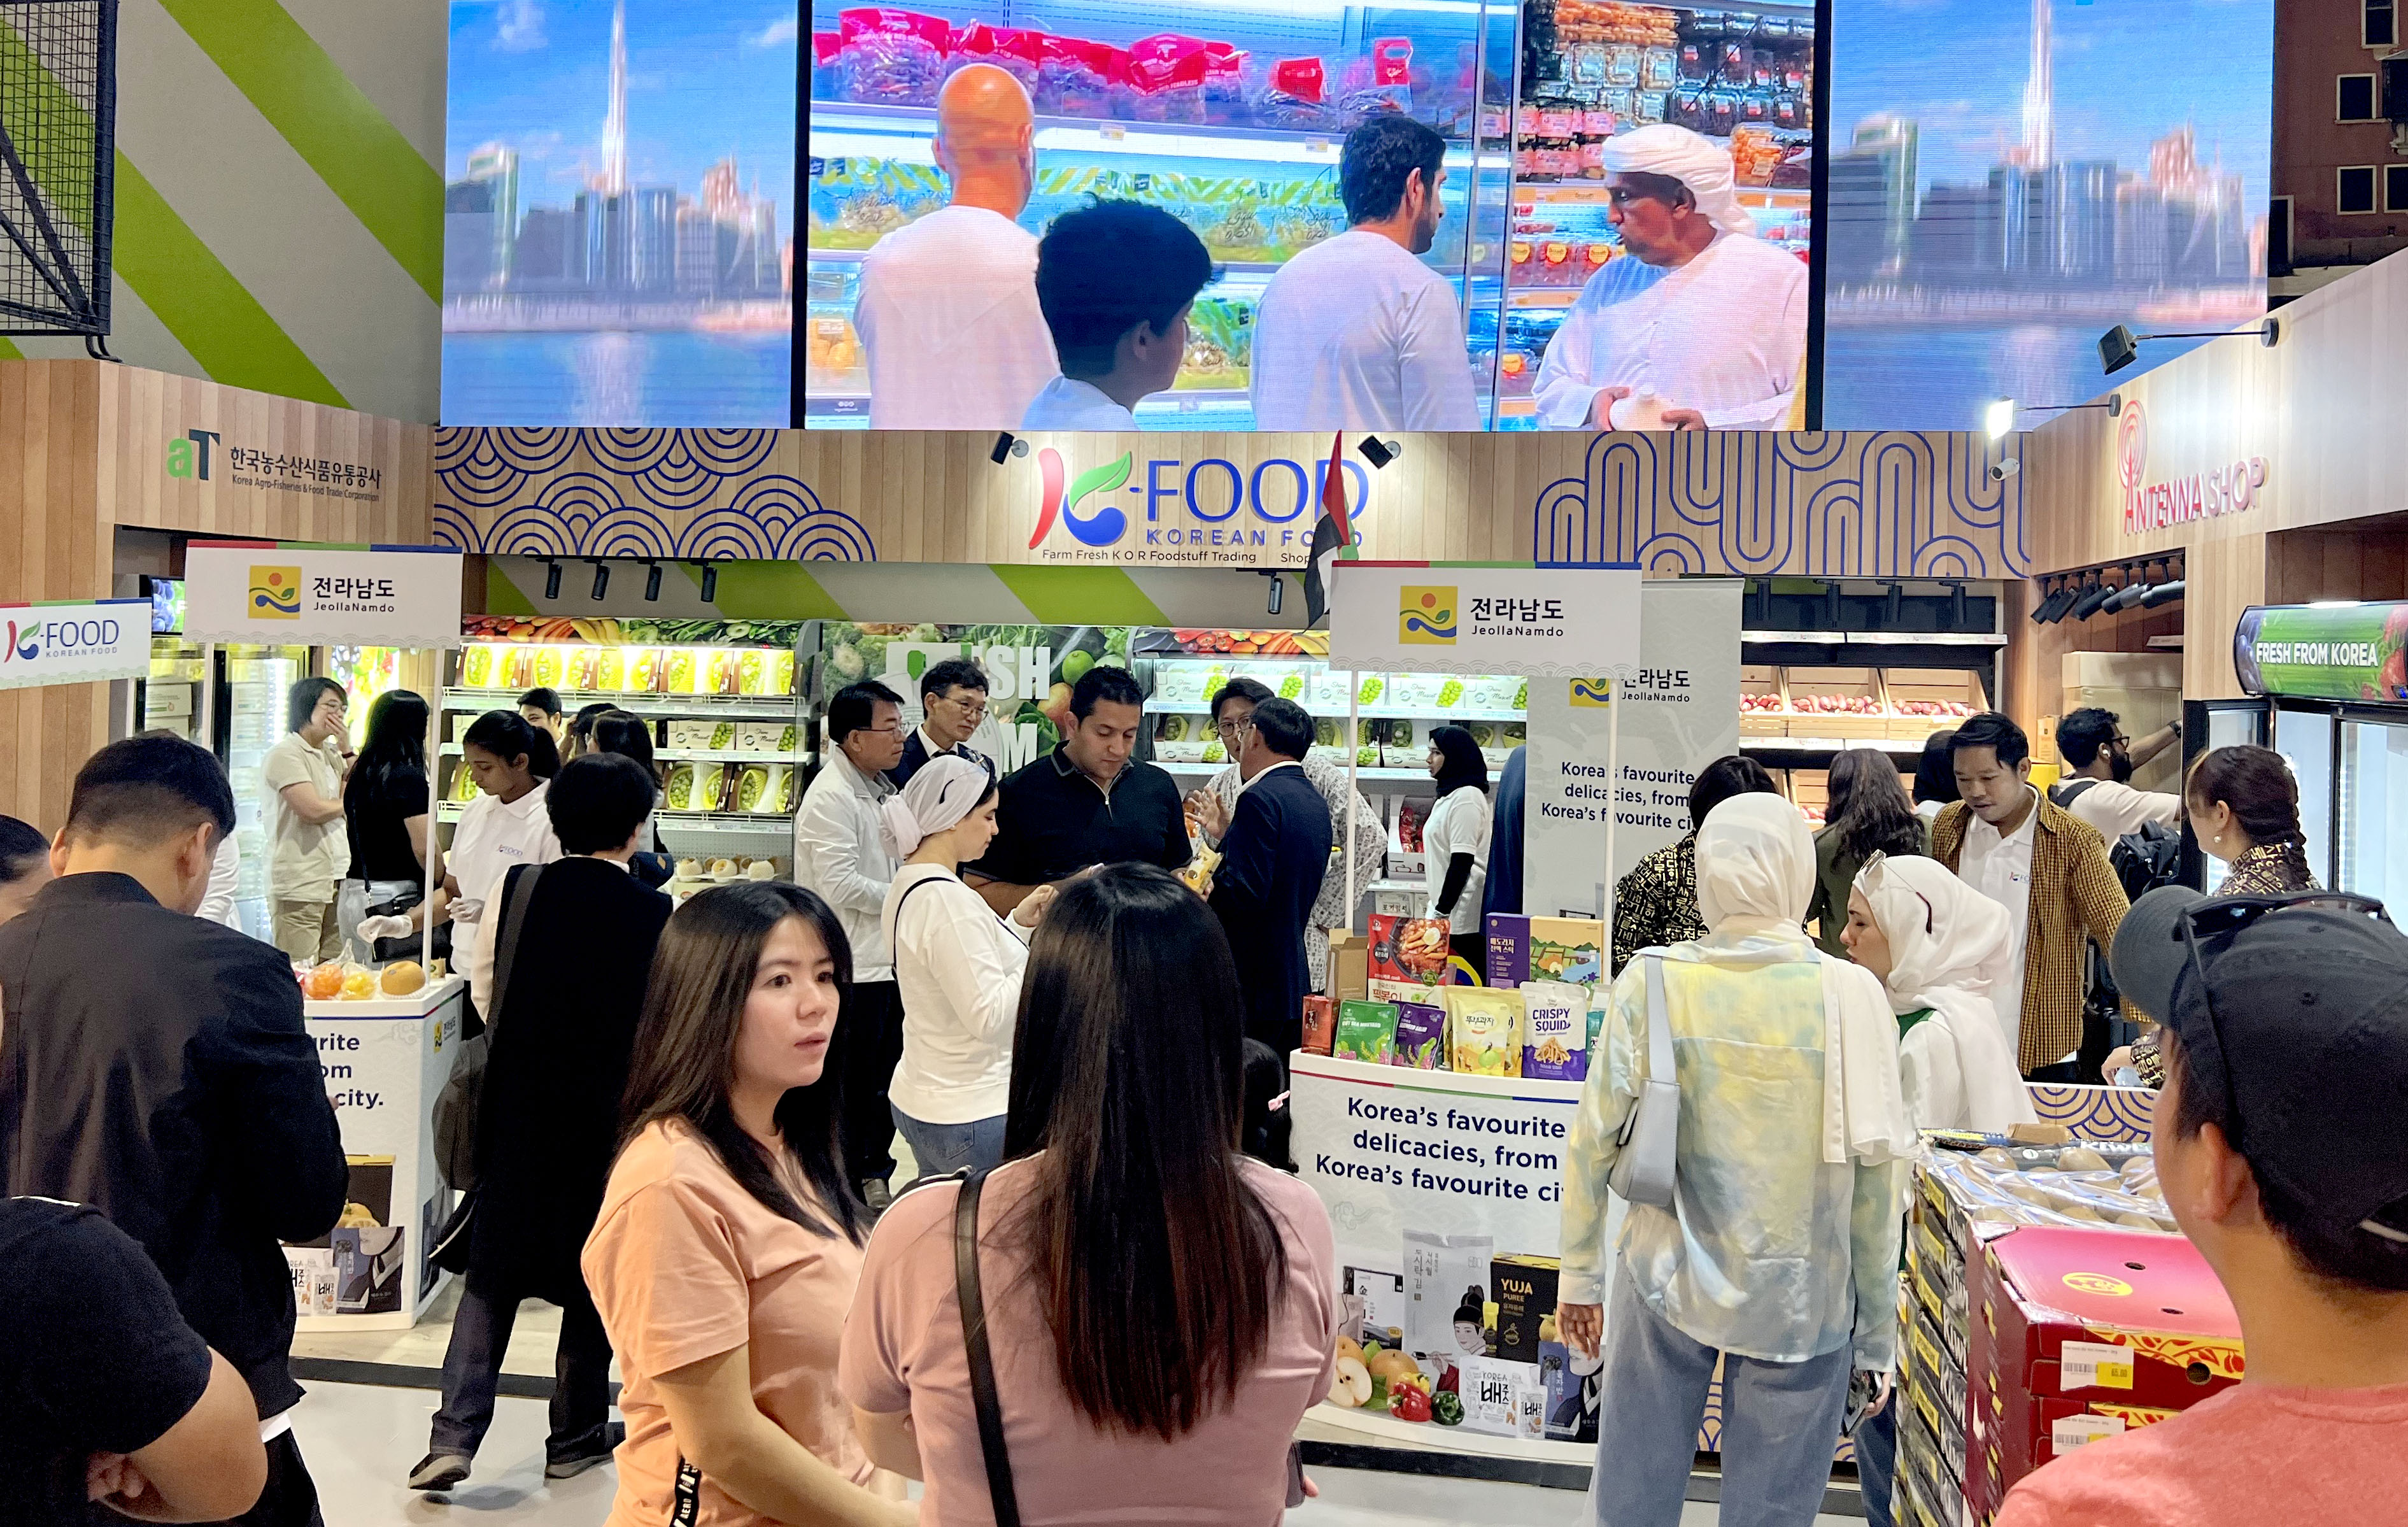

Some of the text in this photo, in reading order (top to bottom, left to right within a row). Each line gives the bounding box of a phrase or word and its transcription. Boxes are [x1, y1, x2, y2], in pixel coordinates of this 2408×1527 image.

[167, 429, 220, 481] aT
[230, 446, 382, 490] 한국농수산식품유통공사
[232, 474, 253, 486] Korea
[255, 477, 302, 493] Agro-Fisheries
[308, 485, 324, 495] Food
[326, 487, 343, 497] Trade
[344, 489, 380, 502] Corporation
[2124, 453, 2268, 537] ANTENNA SHOP
[1146, 528, 1266, 546] KOREAN
[1043, 549, 1072, 560] Farm
[1076, 550, 1108, 560] Fresh
[1113, 551, 1120, 560] K
[1124, 551, 1133, 560] O
[1138, 551, 1146, 560] R
[1150, 550, 1208, 561] Foodstuff
[1212, 551, 1257, 564] Trading
[313, 577, 395, 599] 전라남도
[313, 602, 395, 613] JeollaNamdo
[1470, 597, 1564, 623] 전라남도
[1471, 625, 1564, 637] JeollaNamdo
[46, 646, 118, 658] KOREAN FOOD
[2256, 642, 2379, 667] FRESH FROM KOREA
[1622, 692, 1690, 702] JeollaNamdo
[1562, 761, 1695, 785] Koreas favourite
[1652, 790, 1689, 807] from
[1541, 802, 1691, 830] Korea's fvourite ci
[1533, 1008, 1571, 1019] CRISPY
[1535, 1020, 1571, 1032] SQUID
[334, 1089, 383, 1109] city.
[1348, 1097, 1566, 1139] Korea's favourite
[1353, 1130, 1558, 1170] delicacies, from
[1316, 1154, 1564, 1202] Korea's favourite ci
[1501, 1278, 1533, 1296] YUJA
[1503, 1293, 1525, 1302] PUREE
[1482, 1371, 1508, 1382] KOREA
[2111, 1368, 2128, 1378] 65.00
[679, 1498, 692, 1519] AERO
